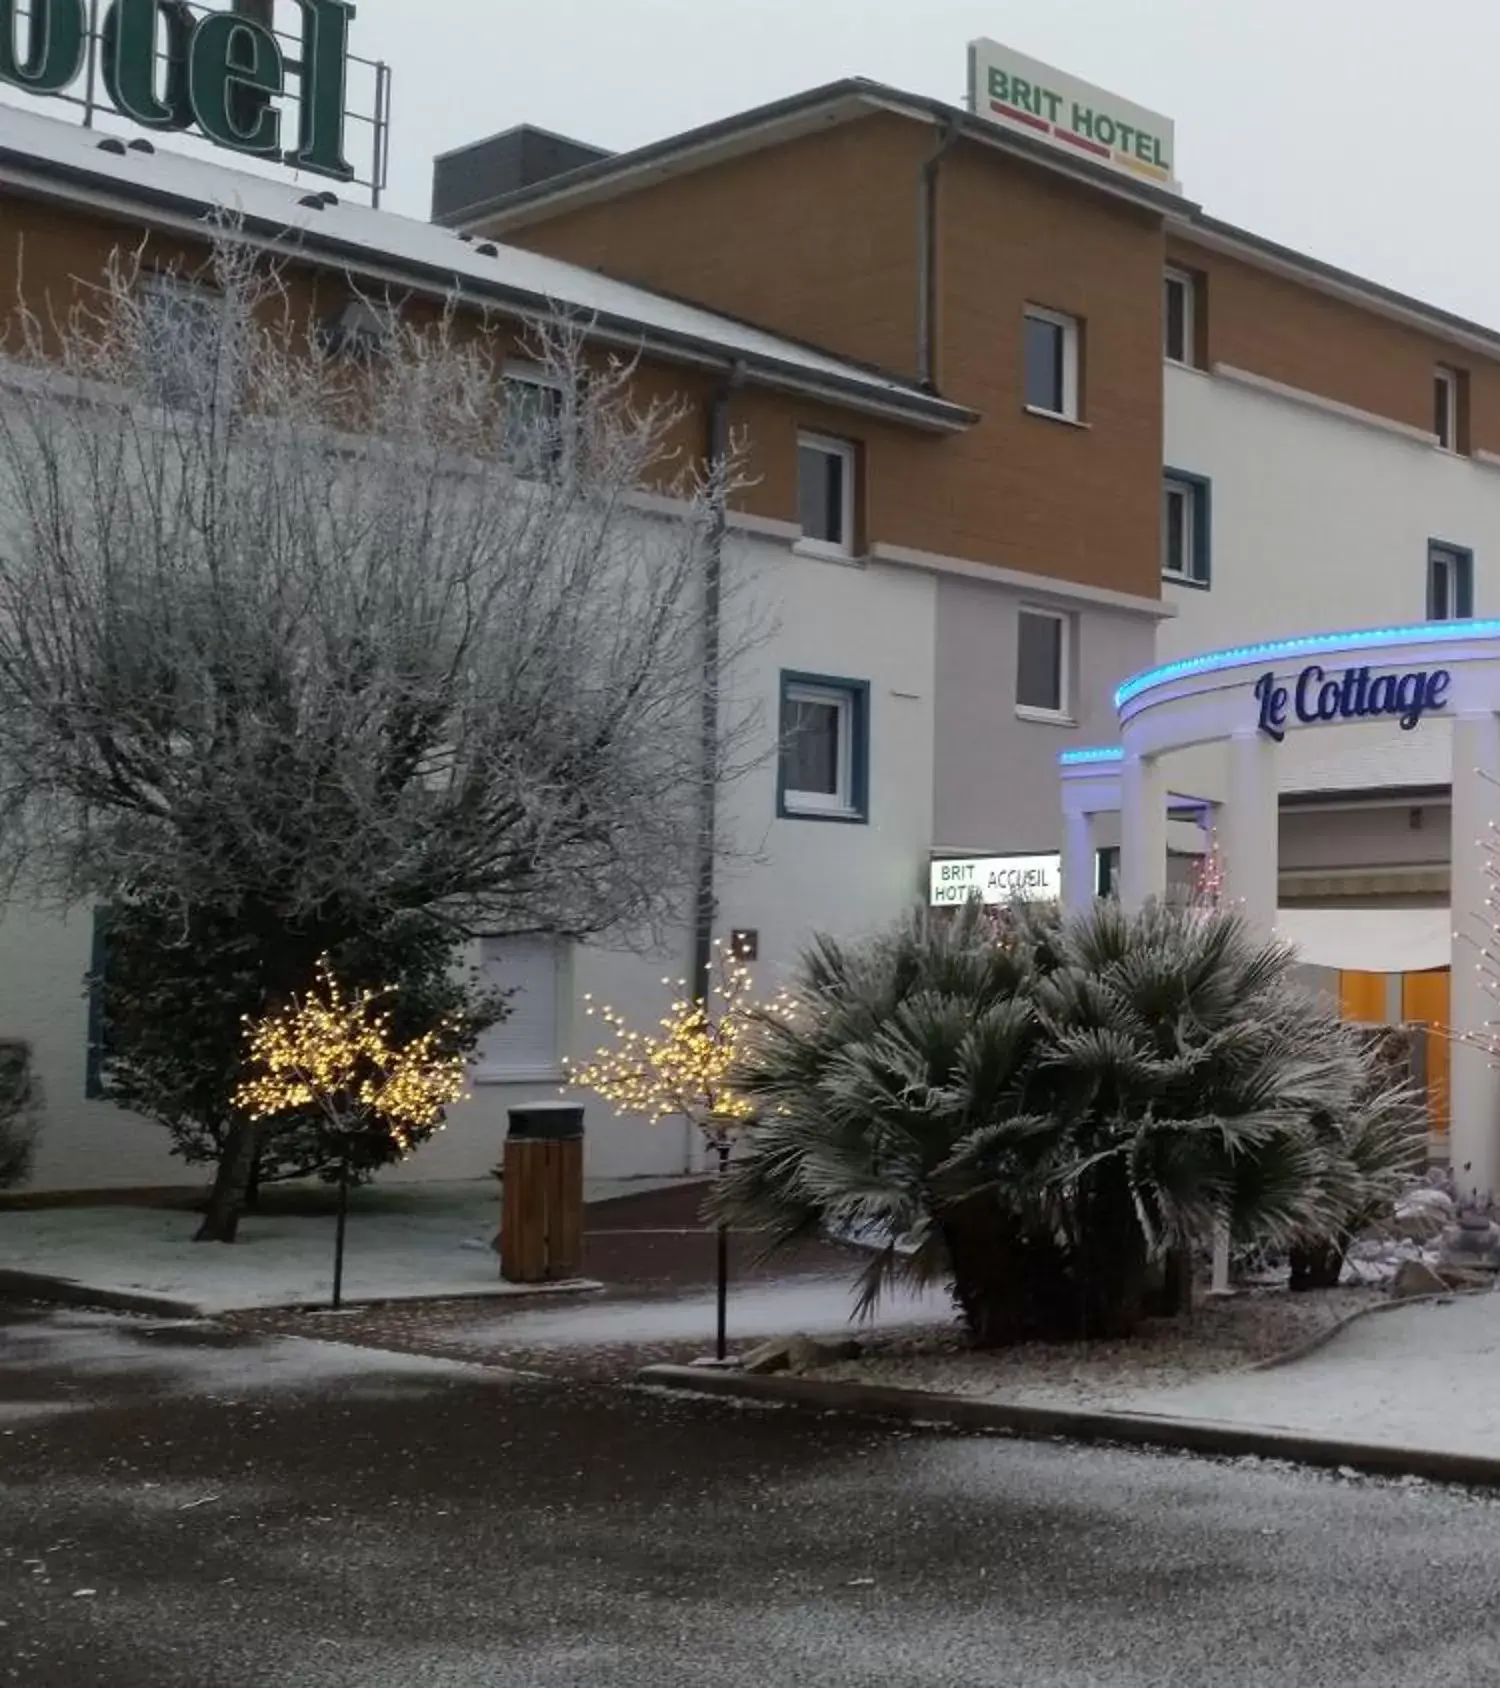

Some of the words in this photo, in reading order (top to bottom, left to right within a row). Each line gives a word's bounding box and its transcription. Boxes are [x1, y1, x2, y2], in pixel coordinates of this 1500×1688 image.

[988, 66, 1063, 122] BRIT
[1072, 102, 1169, 170] HOTEL
[1254, 672, 1288, 742] Le
[1295, 665, 1451, 730] Cottage
[941, 865, 976, 881] BRIT
[988, 869, 1049, 889] ACCUEIL
[935, 885, 983, 901] HOT
